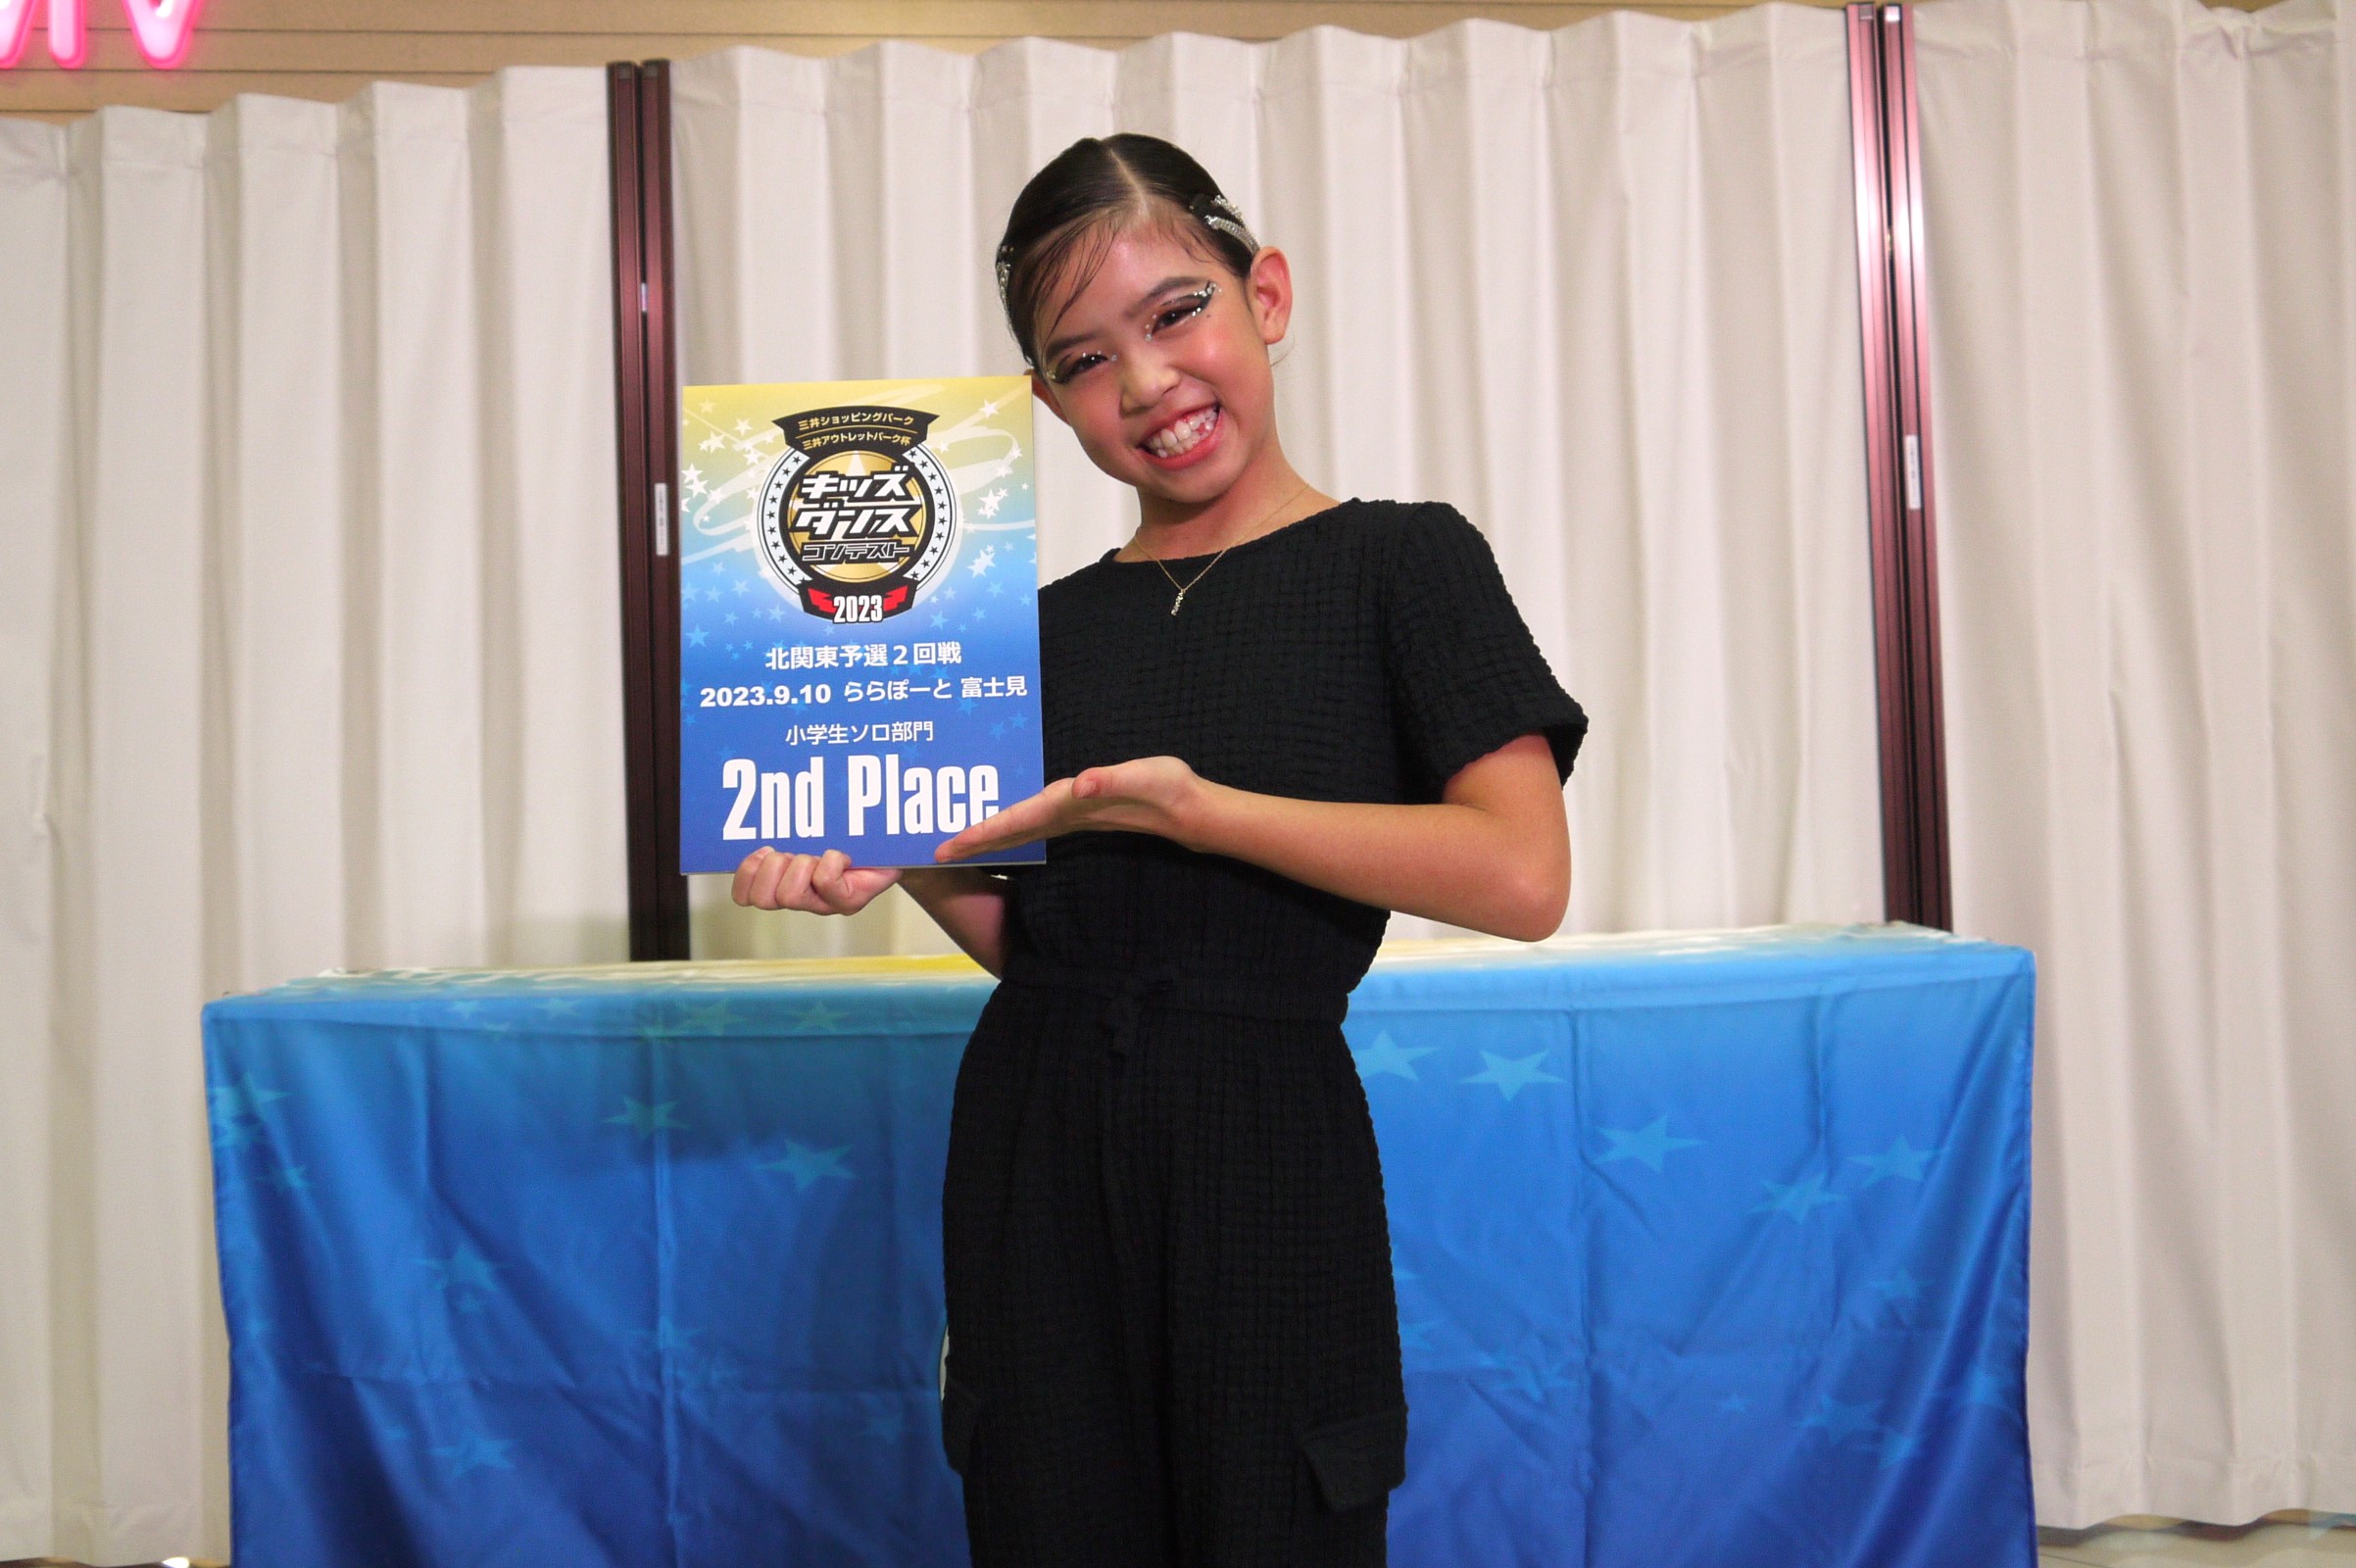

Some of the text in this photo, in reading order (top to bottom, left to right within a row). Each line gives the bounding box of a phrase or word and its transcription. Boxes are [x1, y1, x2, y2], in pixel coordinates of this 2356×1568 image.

[798, 412, 914, 431] 三井ショッピングパーク
[802, 431, 912, 451] 三井アウトレットパーク杯
[801, 466, 908, 499] キッズ
[795, 502, 910, 535] ダンス
[802, 542, 910, 562] コンテスト
[833, 595, 883, 623] 2023
[764, 641, 962, 670] 北関東予選2回戦
[700, 675, 1028, 708] 2023.9.10 ららぽーと 富士見
[785, 720, 934, 746] 小学生ソロ部門
[722, 753, 1000, 841] 2nd Place
